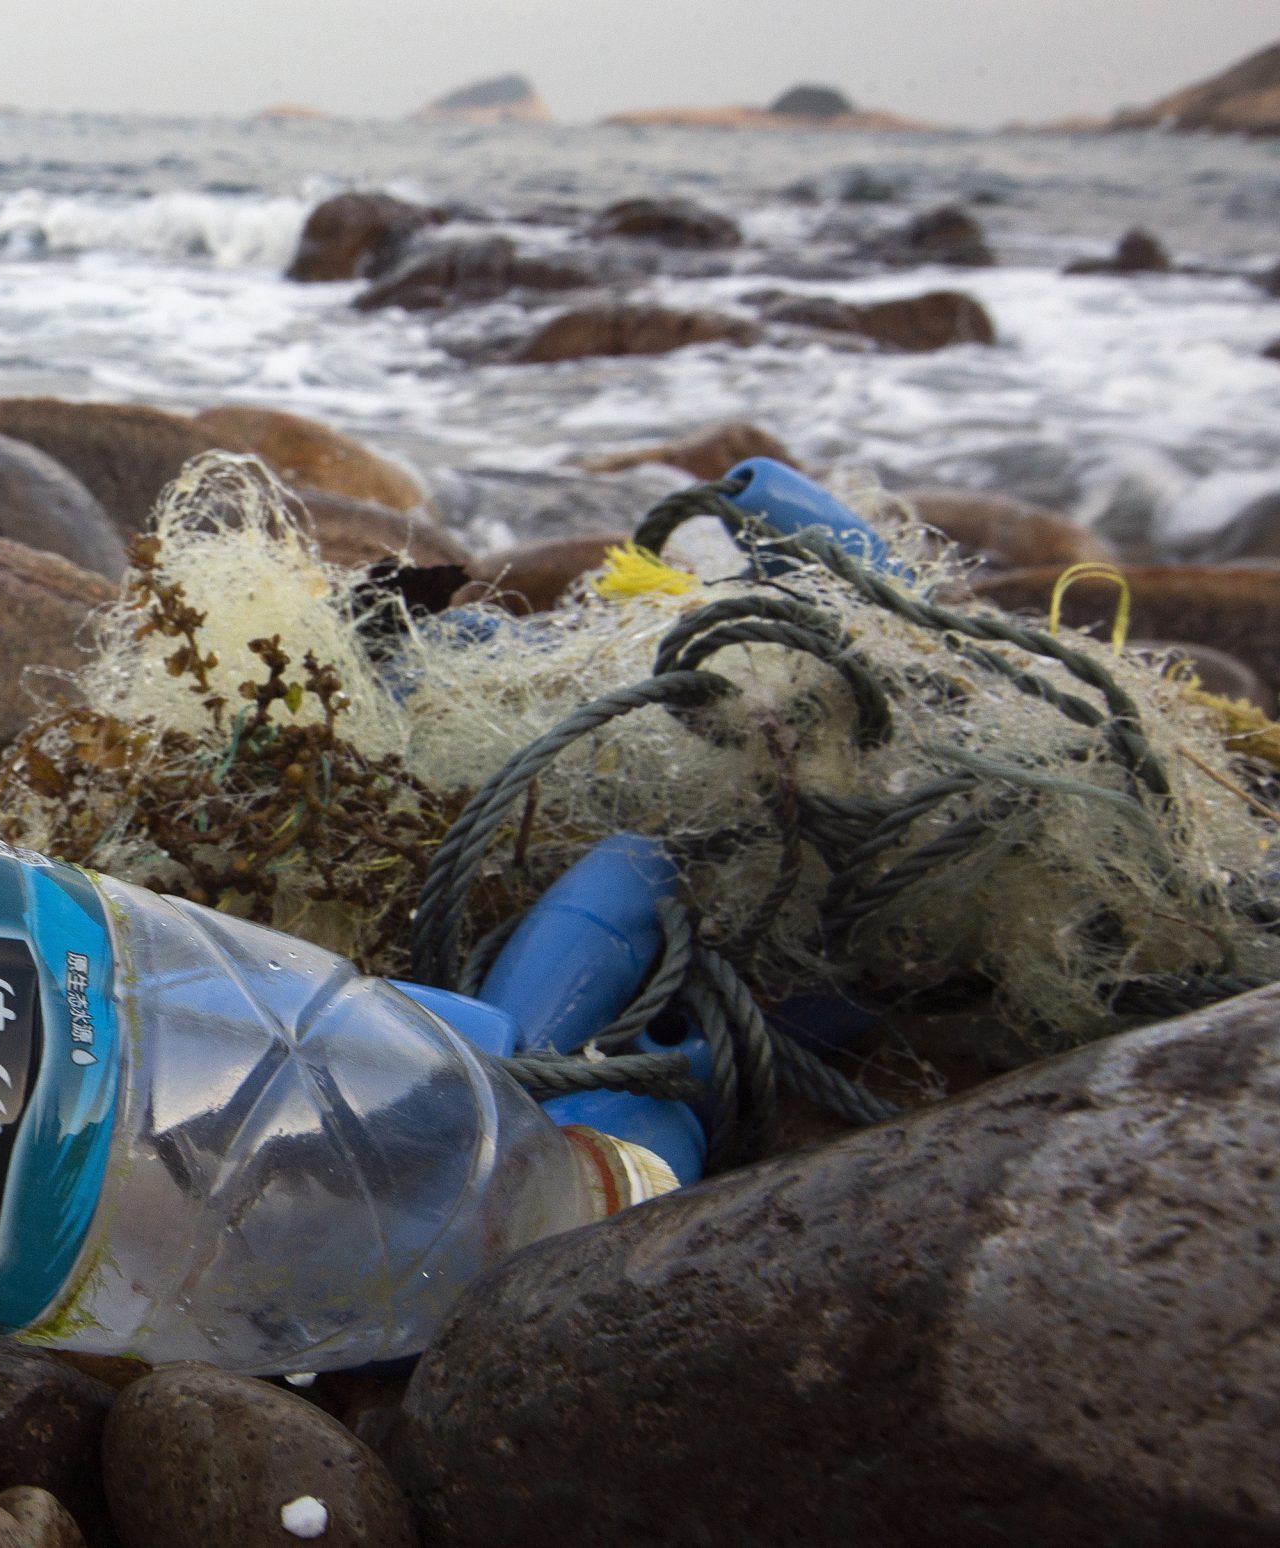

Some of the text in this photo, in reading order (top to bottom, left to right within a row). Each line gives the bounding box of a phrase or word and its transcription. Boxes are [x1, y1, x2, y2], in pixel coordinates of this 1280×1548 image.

[66, 951, 95, 1045] 原生态水源
